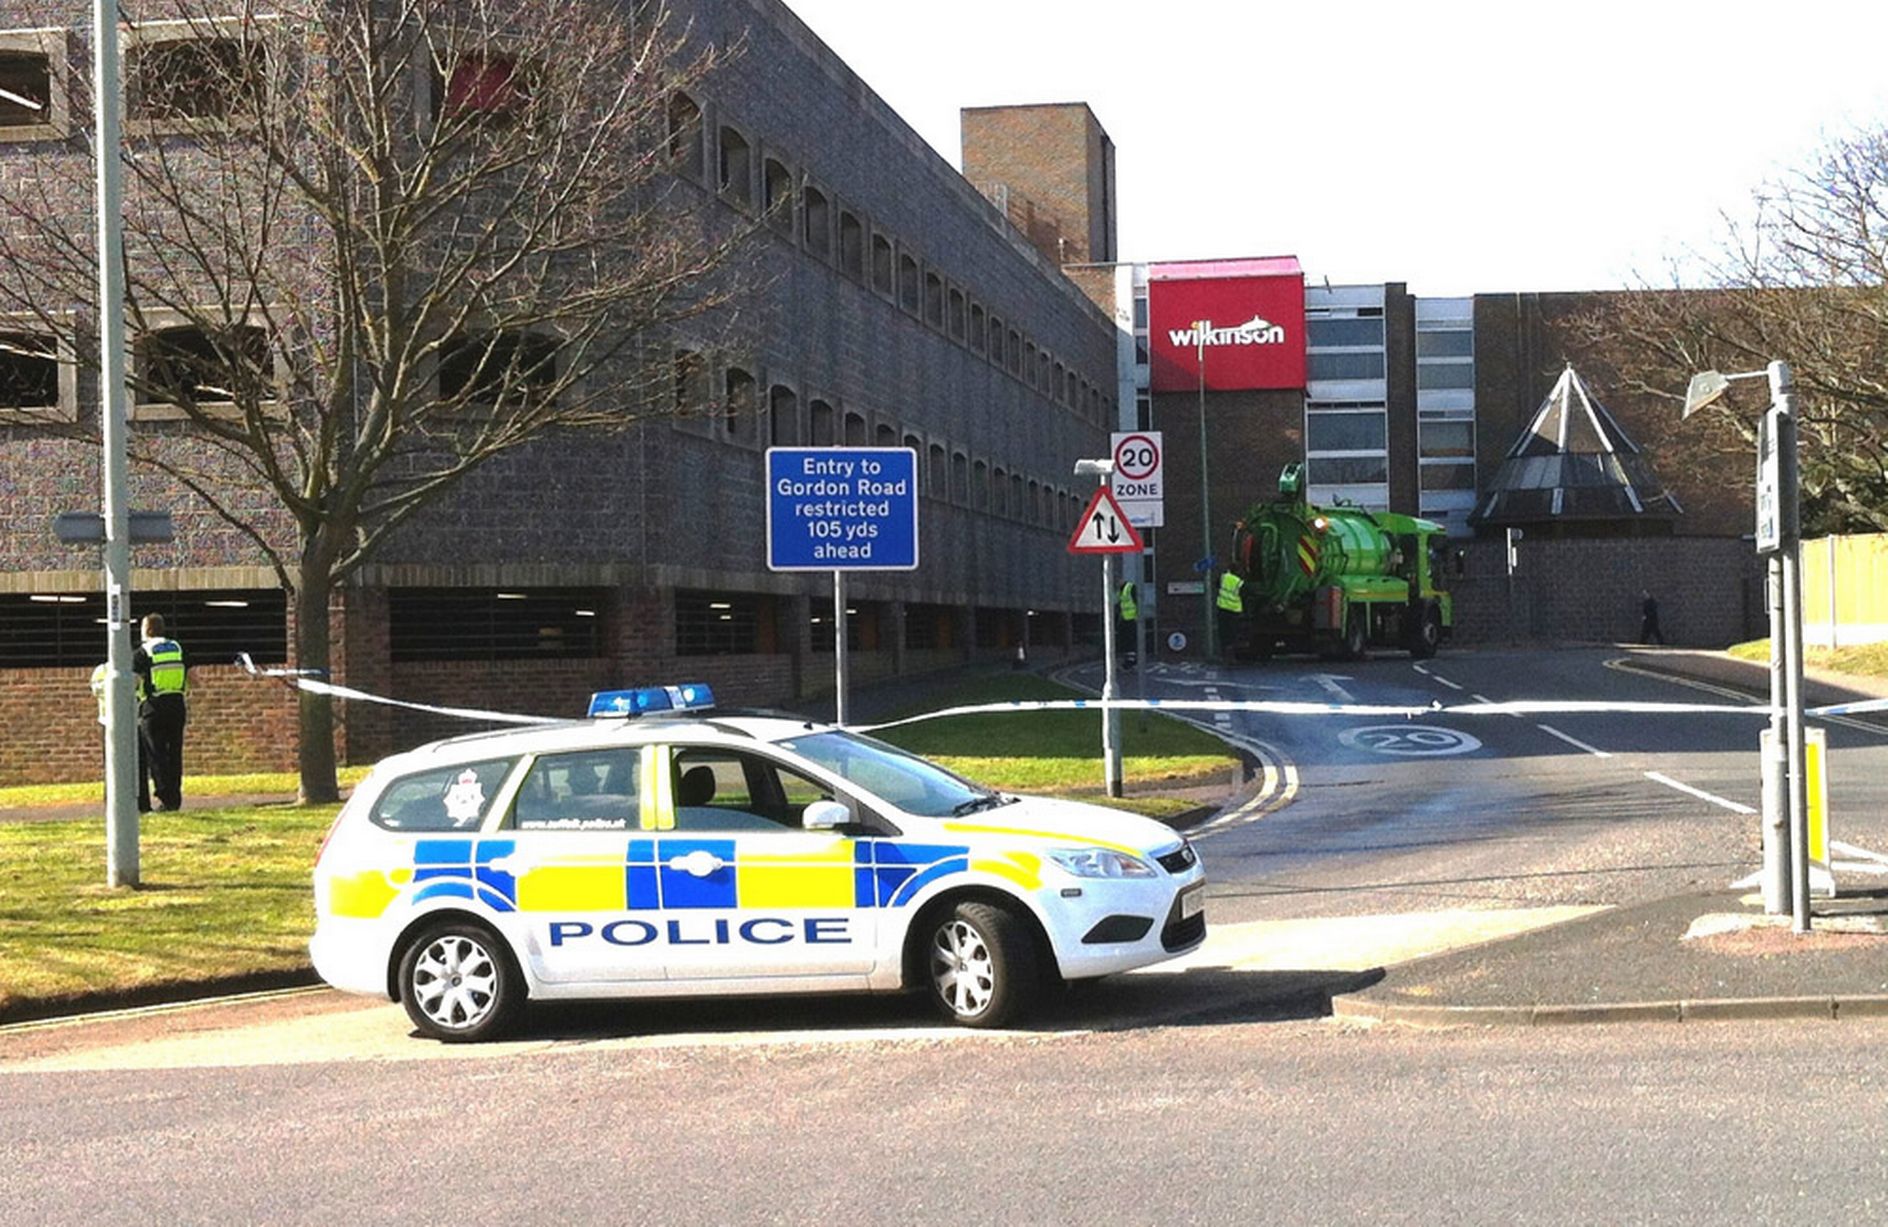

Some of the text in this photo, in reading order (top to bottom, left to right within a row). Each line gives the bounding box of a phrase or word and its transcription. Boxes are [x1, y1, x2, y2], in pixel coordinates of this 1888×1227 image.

[1168, 316, 1285, 347] wilkinson
[1122, 448, 1153, 467] 20
[803, 458, 881, 477] Entry to
[777, 478, 906, 496] Gordon Road
[1117, 483, 1158, 496] ZONE
[795, 500, 889, 516] restricted
[807, 521, 878, 541] 105 yds
[814, 542, 872, 559] ahead
[1364, 732, 1458, 749] 20
[549, 918, 852, 946] POLICE
